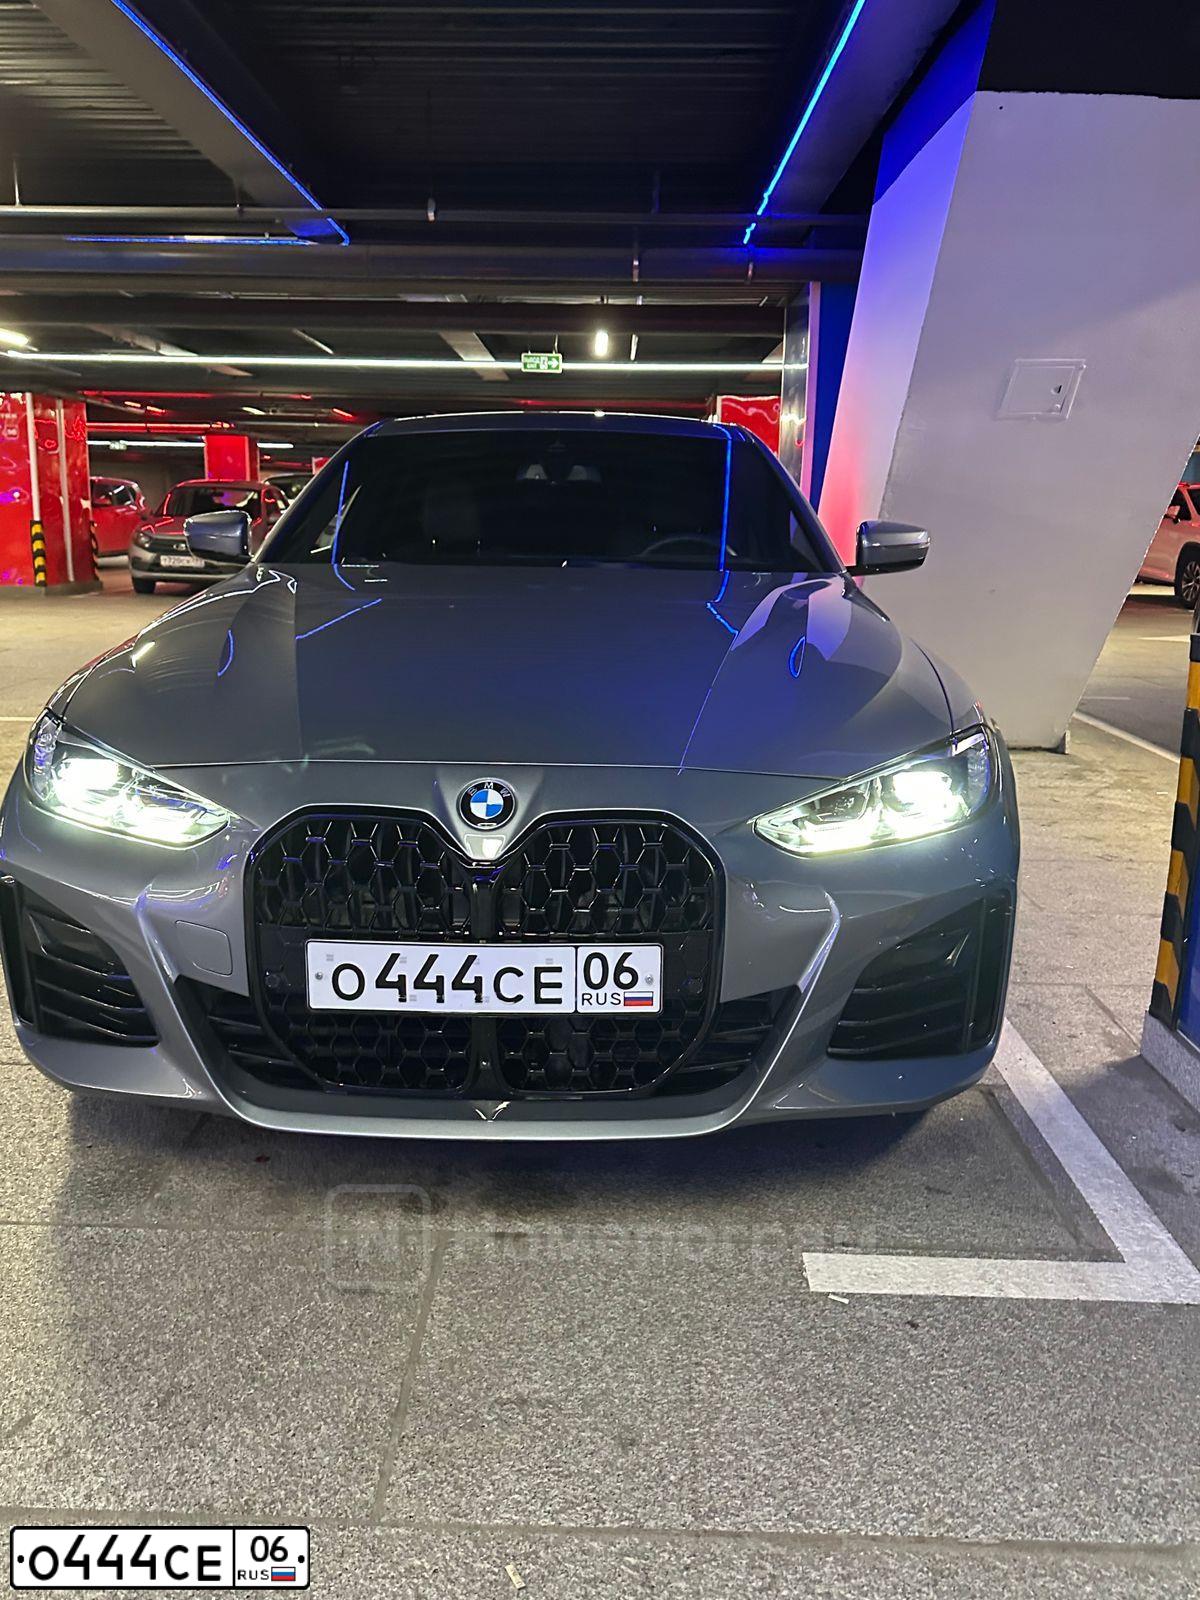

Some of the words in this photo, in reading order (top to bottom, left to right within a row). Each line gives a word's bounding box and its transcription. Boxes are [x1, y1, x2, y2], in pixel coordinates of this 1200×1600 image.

[467, 782, 511, 798] BMW
[583, 951, 639, 990] 06
[581, 992, 621, 1006] RUS
